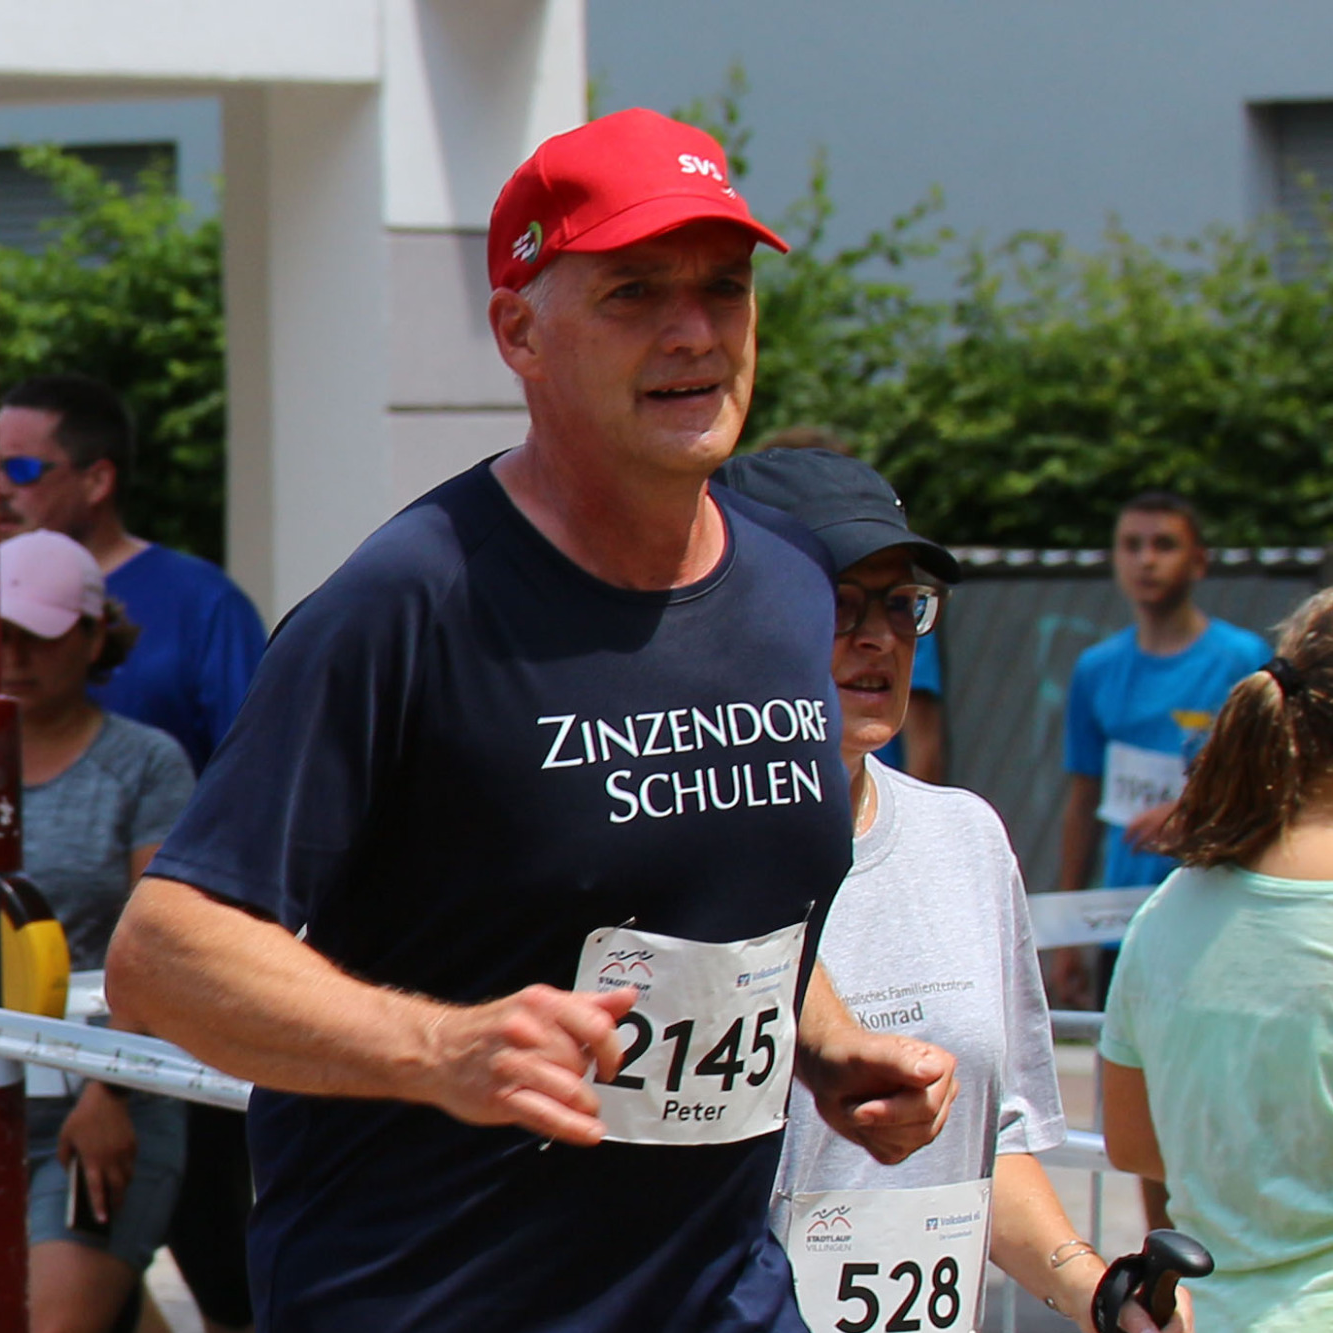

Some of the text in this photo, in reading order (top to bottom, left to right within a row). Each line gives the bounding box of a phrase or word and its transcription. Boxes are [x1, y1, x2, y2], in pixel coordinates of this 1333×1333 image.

[537, 698, 828, 769] ZINZENDORF
[605, 760, 823, 823] SCHULEN
[856, 1001, 925, 1031] Konrad
[593, 1006, 779, 1093] 2145
[662, 1100, 727, 1121] Peter
[806, 1235, 852, 1243] STADTLAUF
[806, 1243, 852, 1252] VILLINGEN
